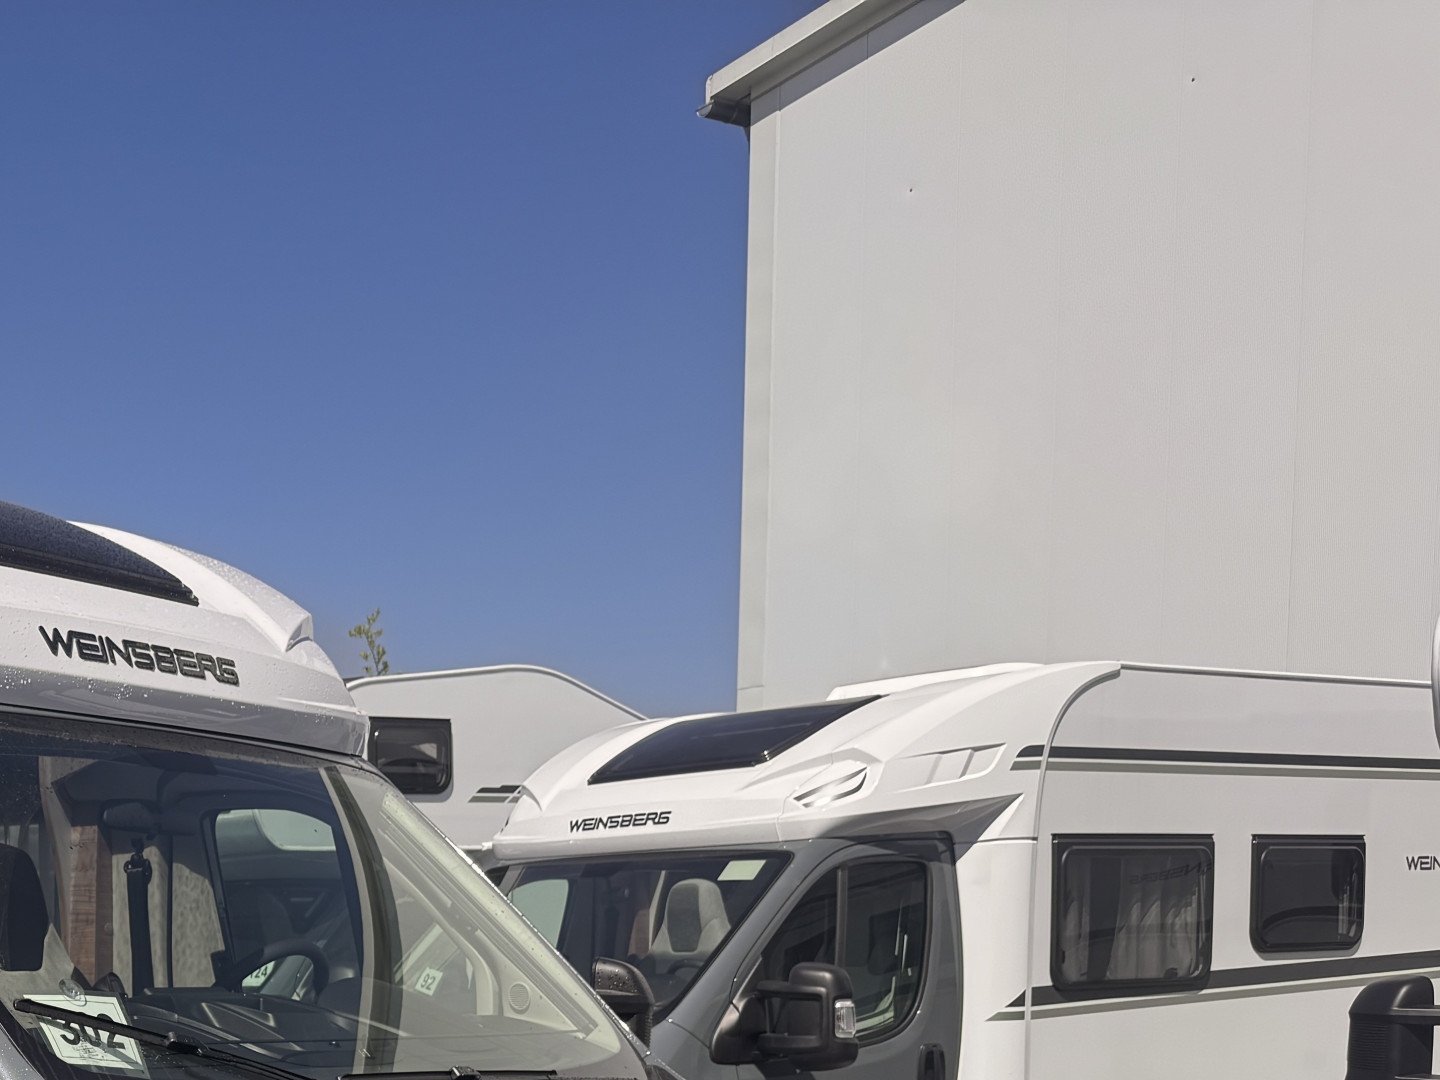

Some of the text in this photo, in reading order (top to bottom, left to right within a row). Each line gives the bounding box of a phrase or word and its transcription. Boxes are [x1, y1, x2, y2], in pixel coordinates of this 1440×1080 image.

[38, 625, 240, 687] WEINSBERG
[569, 811, 672, 833] WEINSBERG
[420, 973, 436, 991] 92
